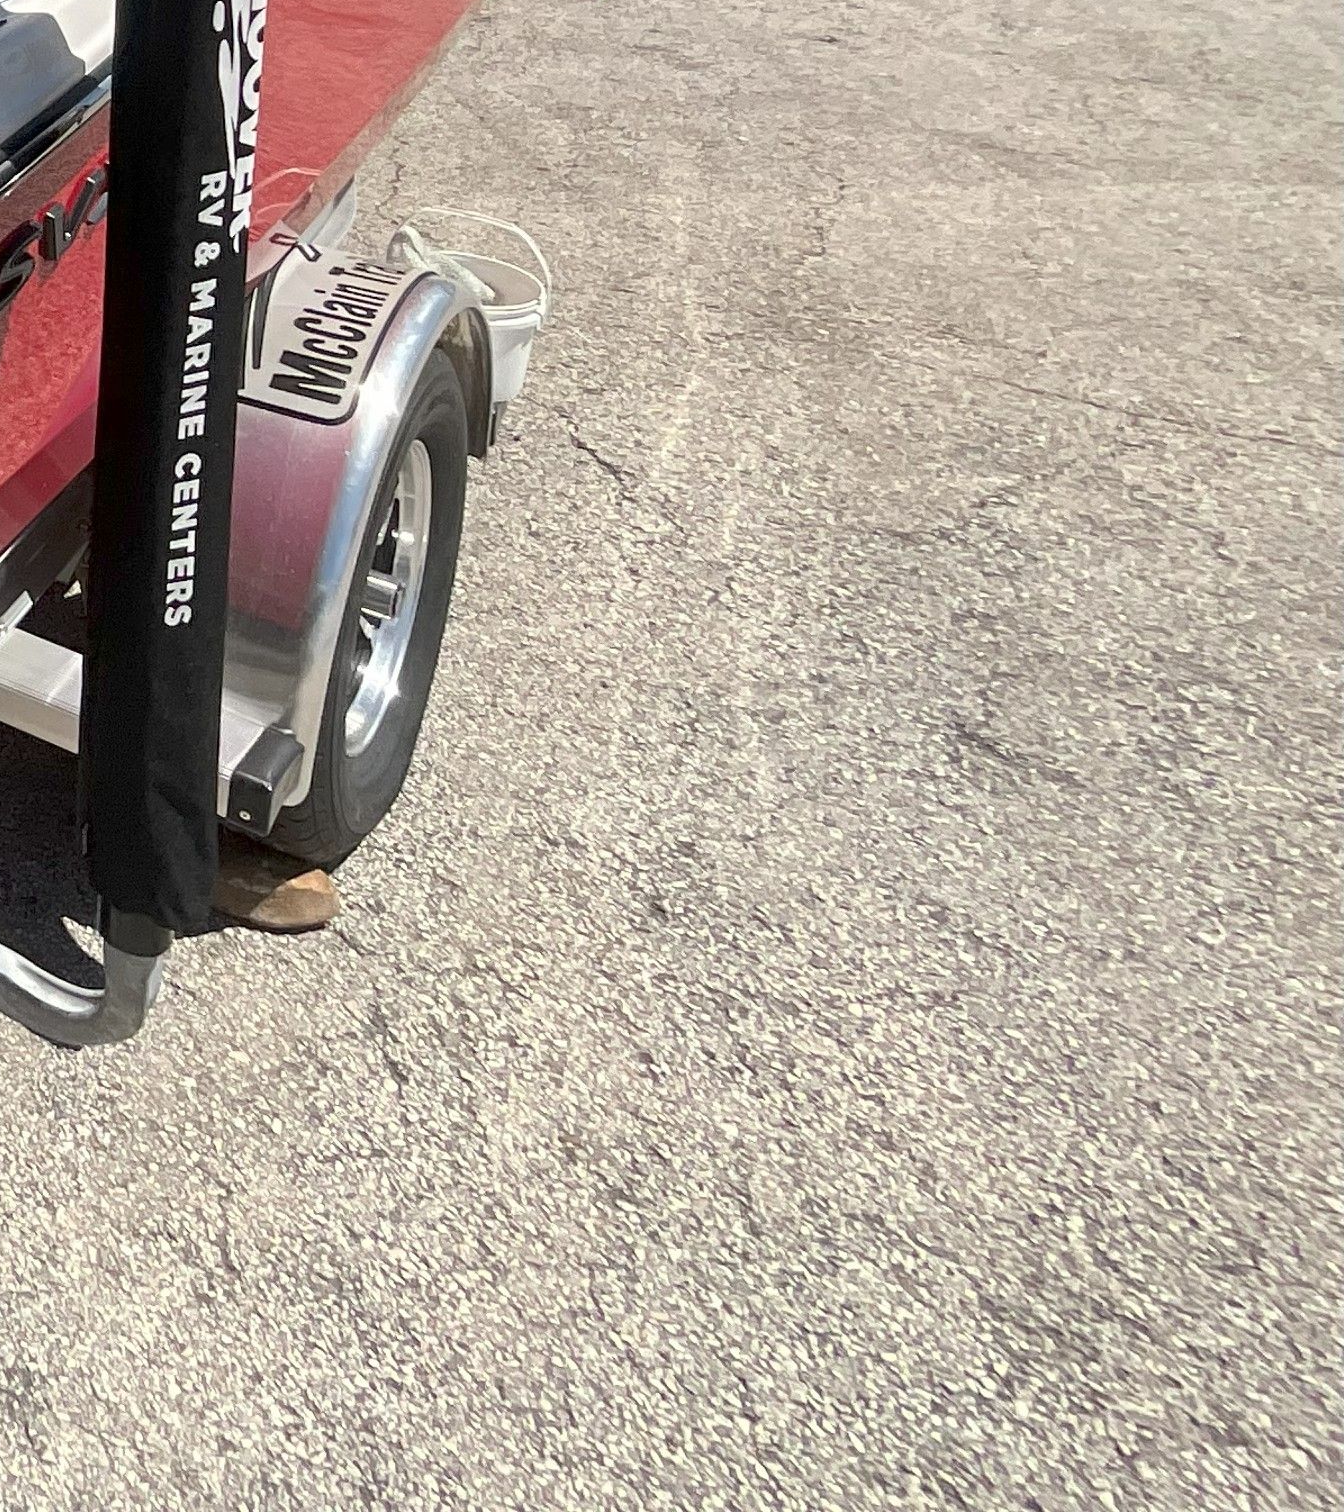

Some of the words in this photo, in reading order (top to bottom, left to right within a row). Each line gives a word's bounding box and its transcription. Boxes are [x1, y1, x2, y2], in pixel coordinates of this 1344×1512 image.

[194, 241, 221, 268] &
[198, 171, 228, 227] RV
[177, 278, 217, 440] MARINE
[269, 283, 390, 405] McClain
[164, 452, 203, 627] CENTERS
